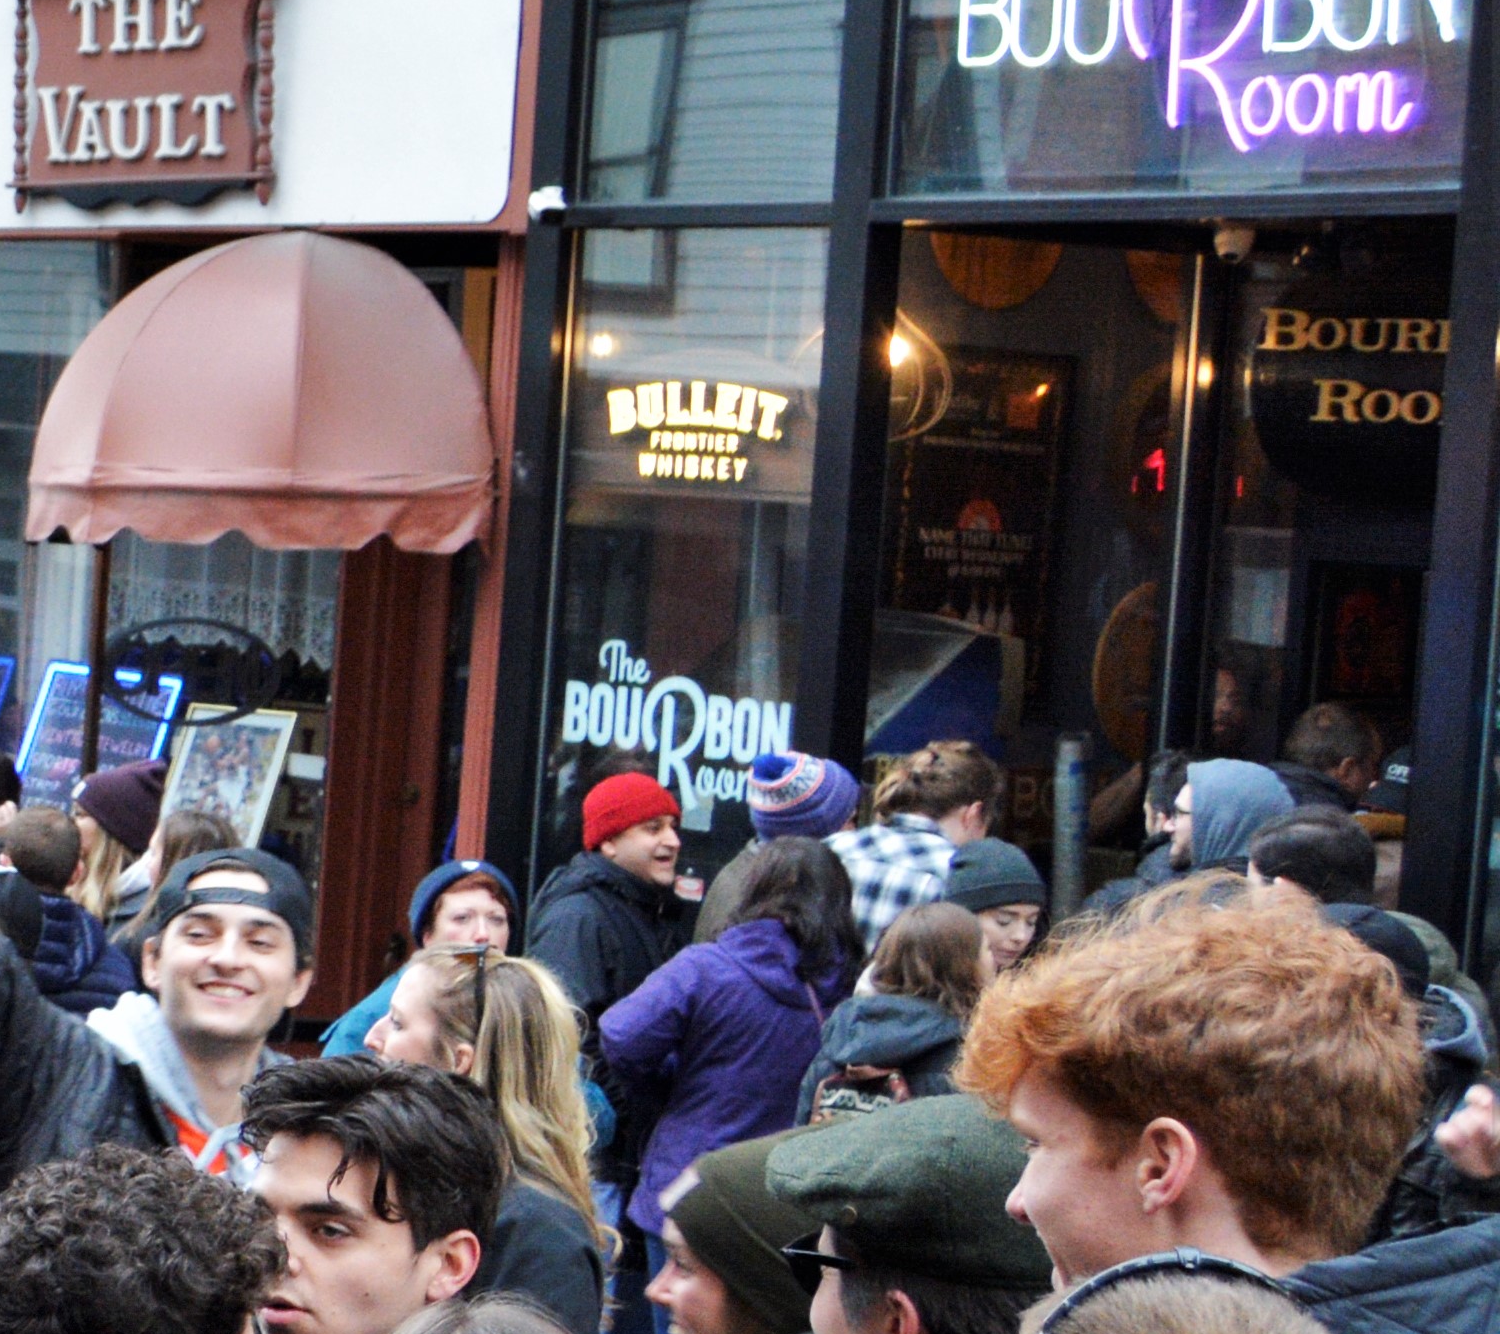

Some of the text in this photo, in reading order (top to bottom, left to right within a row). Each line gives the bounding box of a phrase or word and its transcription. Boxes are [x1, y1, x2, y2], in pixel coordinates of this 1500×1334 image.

[37, 85, 237, 164] VAULT
[650, 430, 739, 454] FRONTIER
[638, 452, 748, 482] WHISKEY
[599, 639, 651, 684] The
[563, 676, 790, 809] BOURBON
